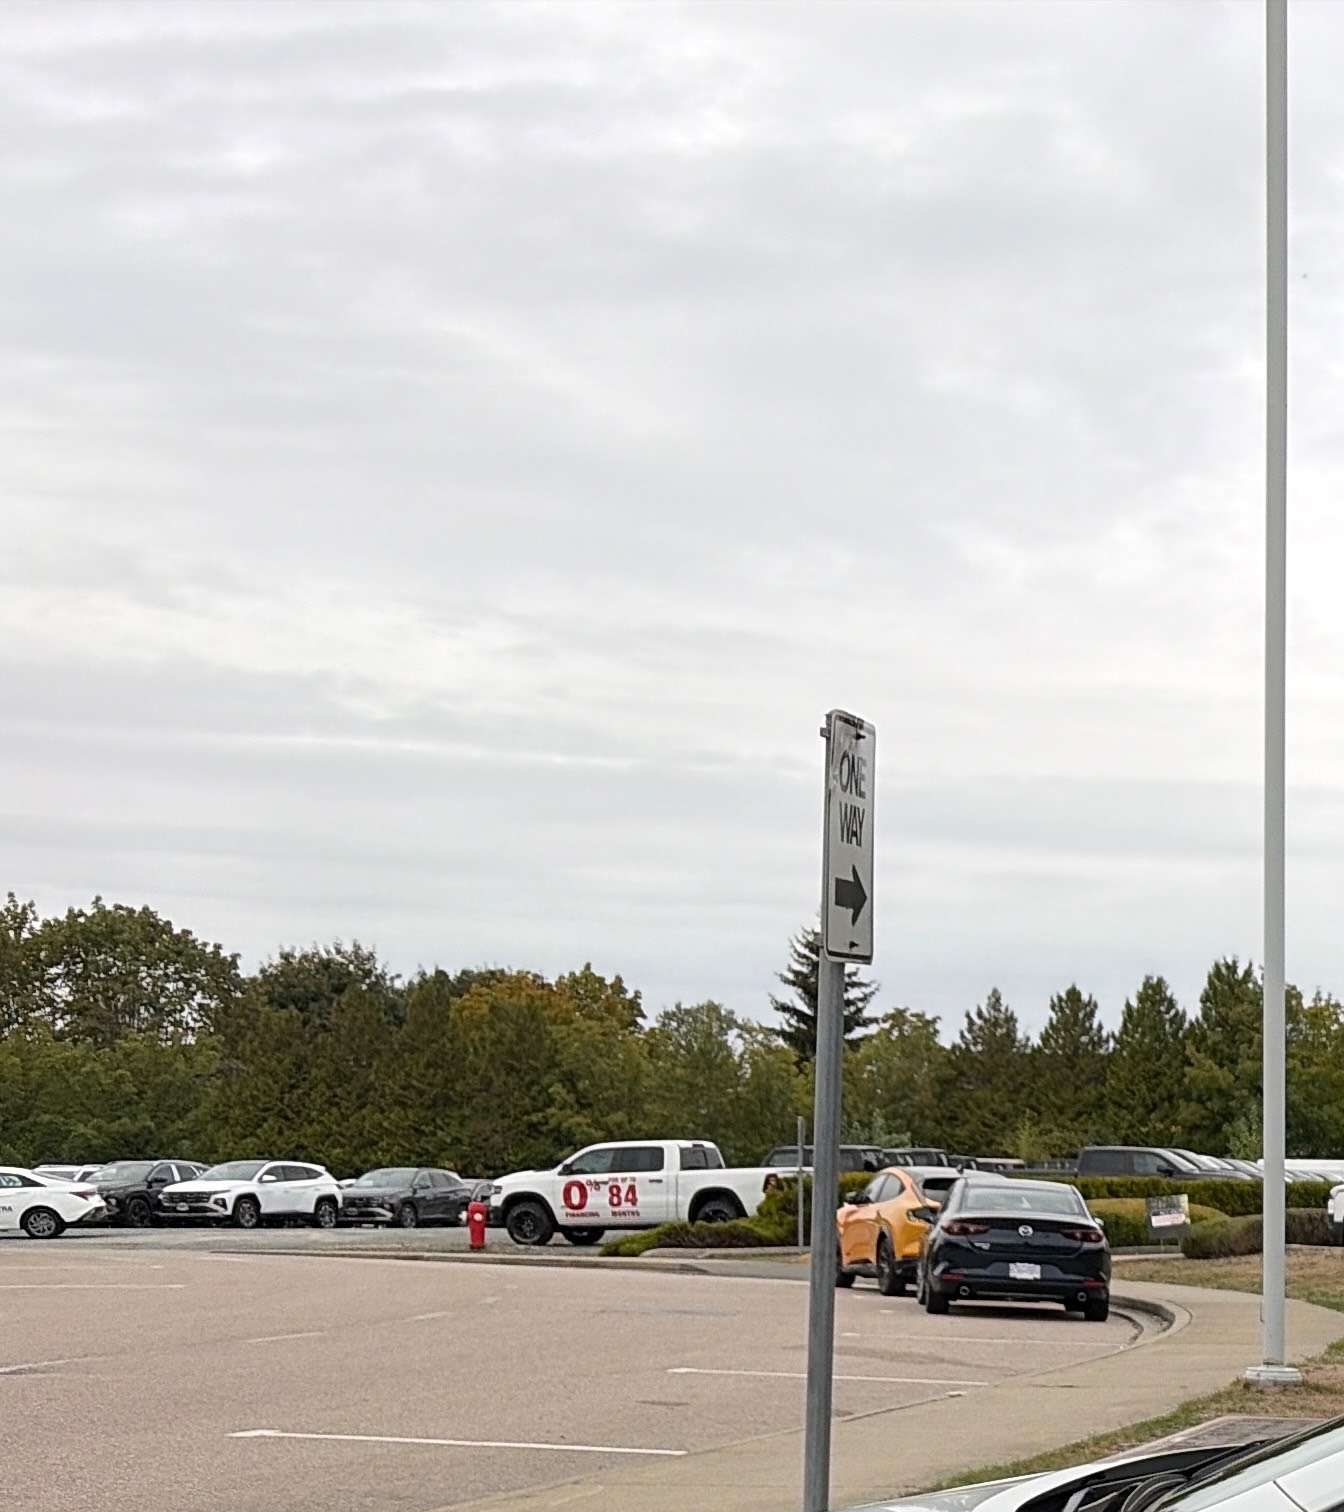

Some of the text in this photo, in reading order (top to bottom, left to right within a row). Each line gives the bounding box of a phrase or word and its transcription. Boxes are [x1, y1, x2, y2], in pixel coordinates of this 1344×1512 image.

[839, 750, 867, 800] ONE
[839, 800, 866, 848] WAY
[608, 1184, 639, 1207] 84
